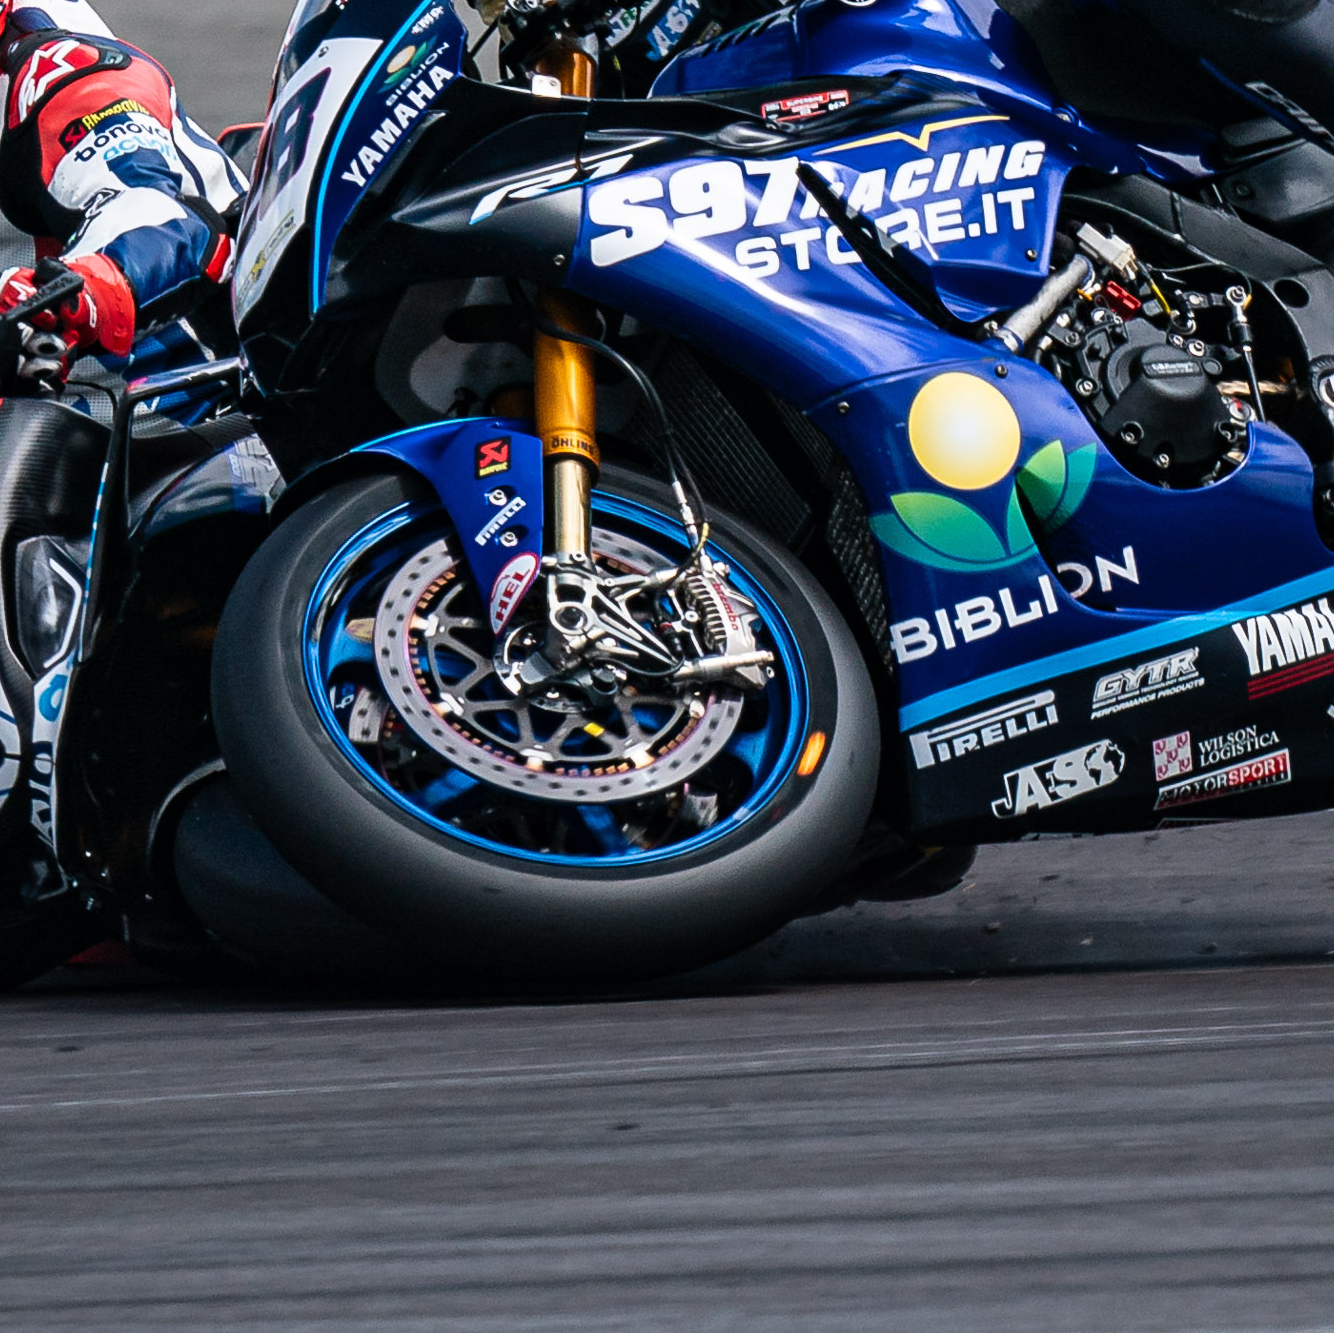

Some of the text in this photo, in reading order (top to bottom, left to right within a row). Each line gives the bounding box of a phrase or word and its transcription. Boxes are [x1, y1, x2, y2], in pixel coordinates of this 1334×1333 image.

[341, 65, 454, 188] YAMAHA
[588, 156, 799, 267] S97
[734, 187, 1035, 280] STORE.IT
[475, 496, 527, 546] PIRELLI
[495, 567, 530, 622] HEL
[711, 580, 739, 631] brembo
[890, 545, 1140, 664] BIBLION
[1090, 677, 1206, 720] PERFORMANCE PRODUCTS
[1092, 646, 1200, 702] GYTR
[909, 689, 1059, 770] PIRELLI
[1198, 724, 1258, 756] WILSON
[1200, 730, 1281, 767] LOGISTICA
[1159, 755, 1287, 801] MOTORSPORT
